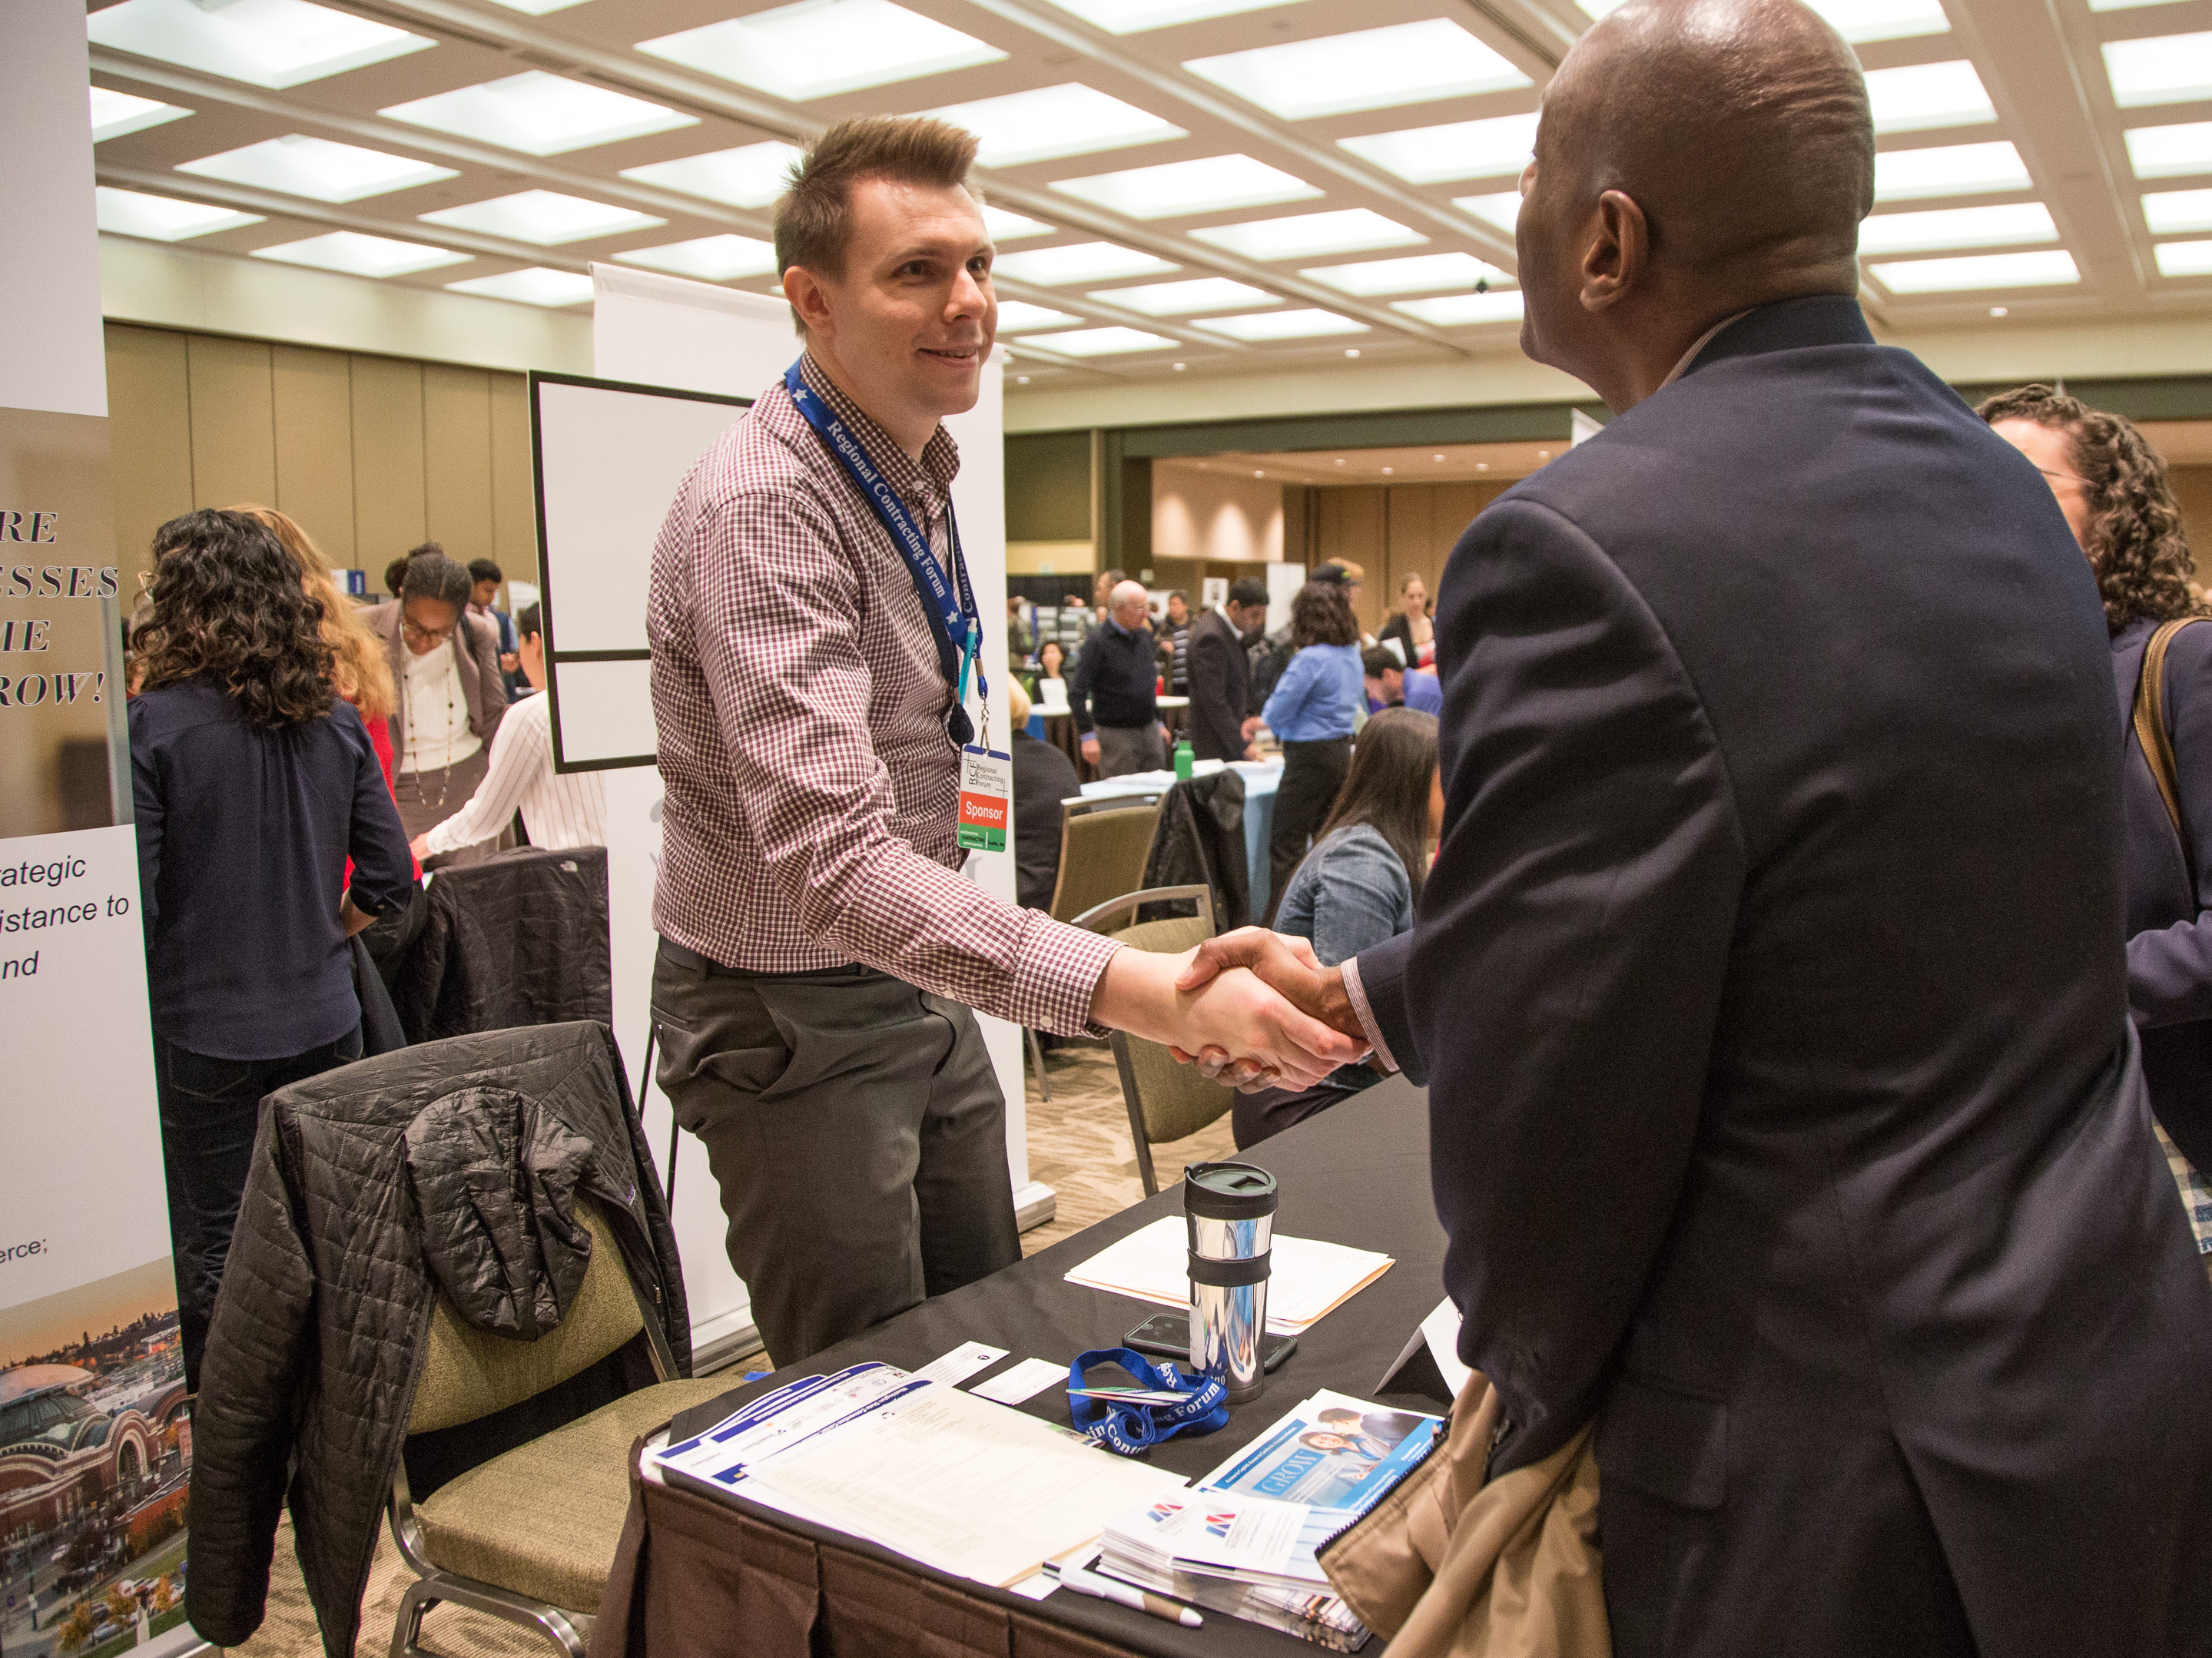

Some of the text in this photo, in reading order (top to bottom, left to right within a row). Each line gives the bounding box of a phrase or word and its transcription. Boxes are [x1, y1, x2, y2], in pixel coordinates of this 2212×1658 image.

[826, 420, 946, 599] Regional Contracting Forum
[0, 565, 119, 598] SSES
[977, 764, 997, 774] Regional
[977, 772, 1003, 784] Contracting
[977, 779, 991, 788] Forum
[966, 801, 1003, 821] Sponsor
[0, 855, 87, 887] ategic
[107, 894, 130, 917] to
[2, 950, 40, 980] nd
[1173, 1382, 1221, 1418] Forum
[1262, 1451, 1317, 1492] GROW
